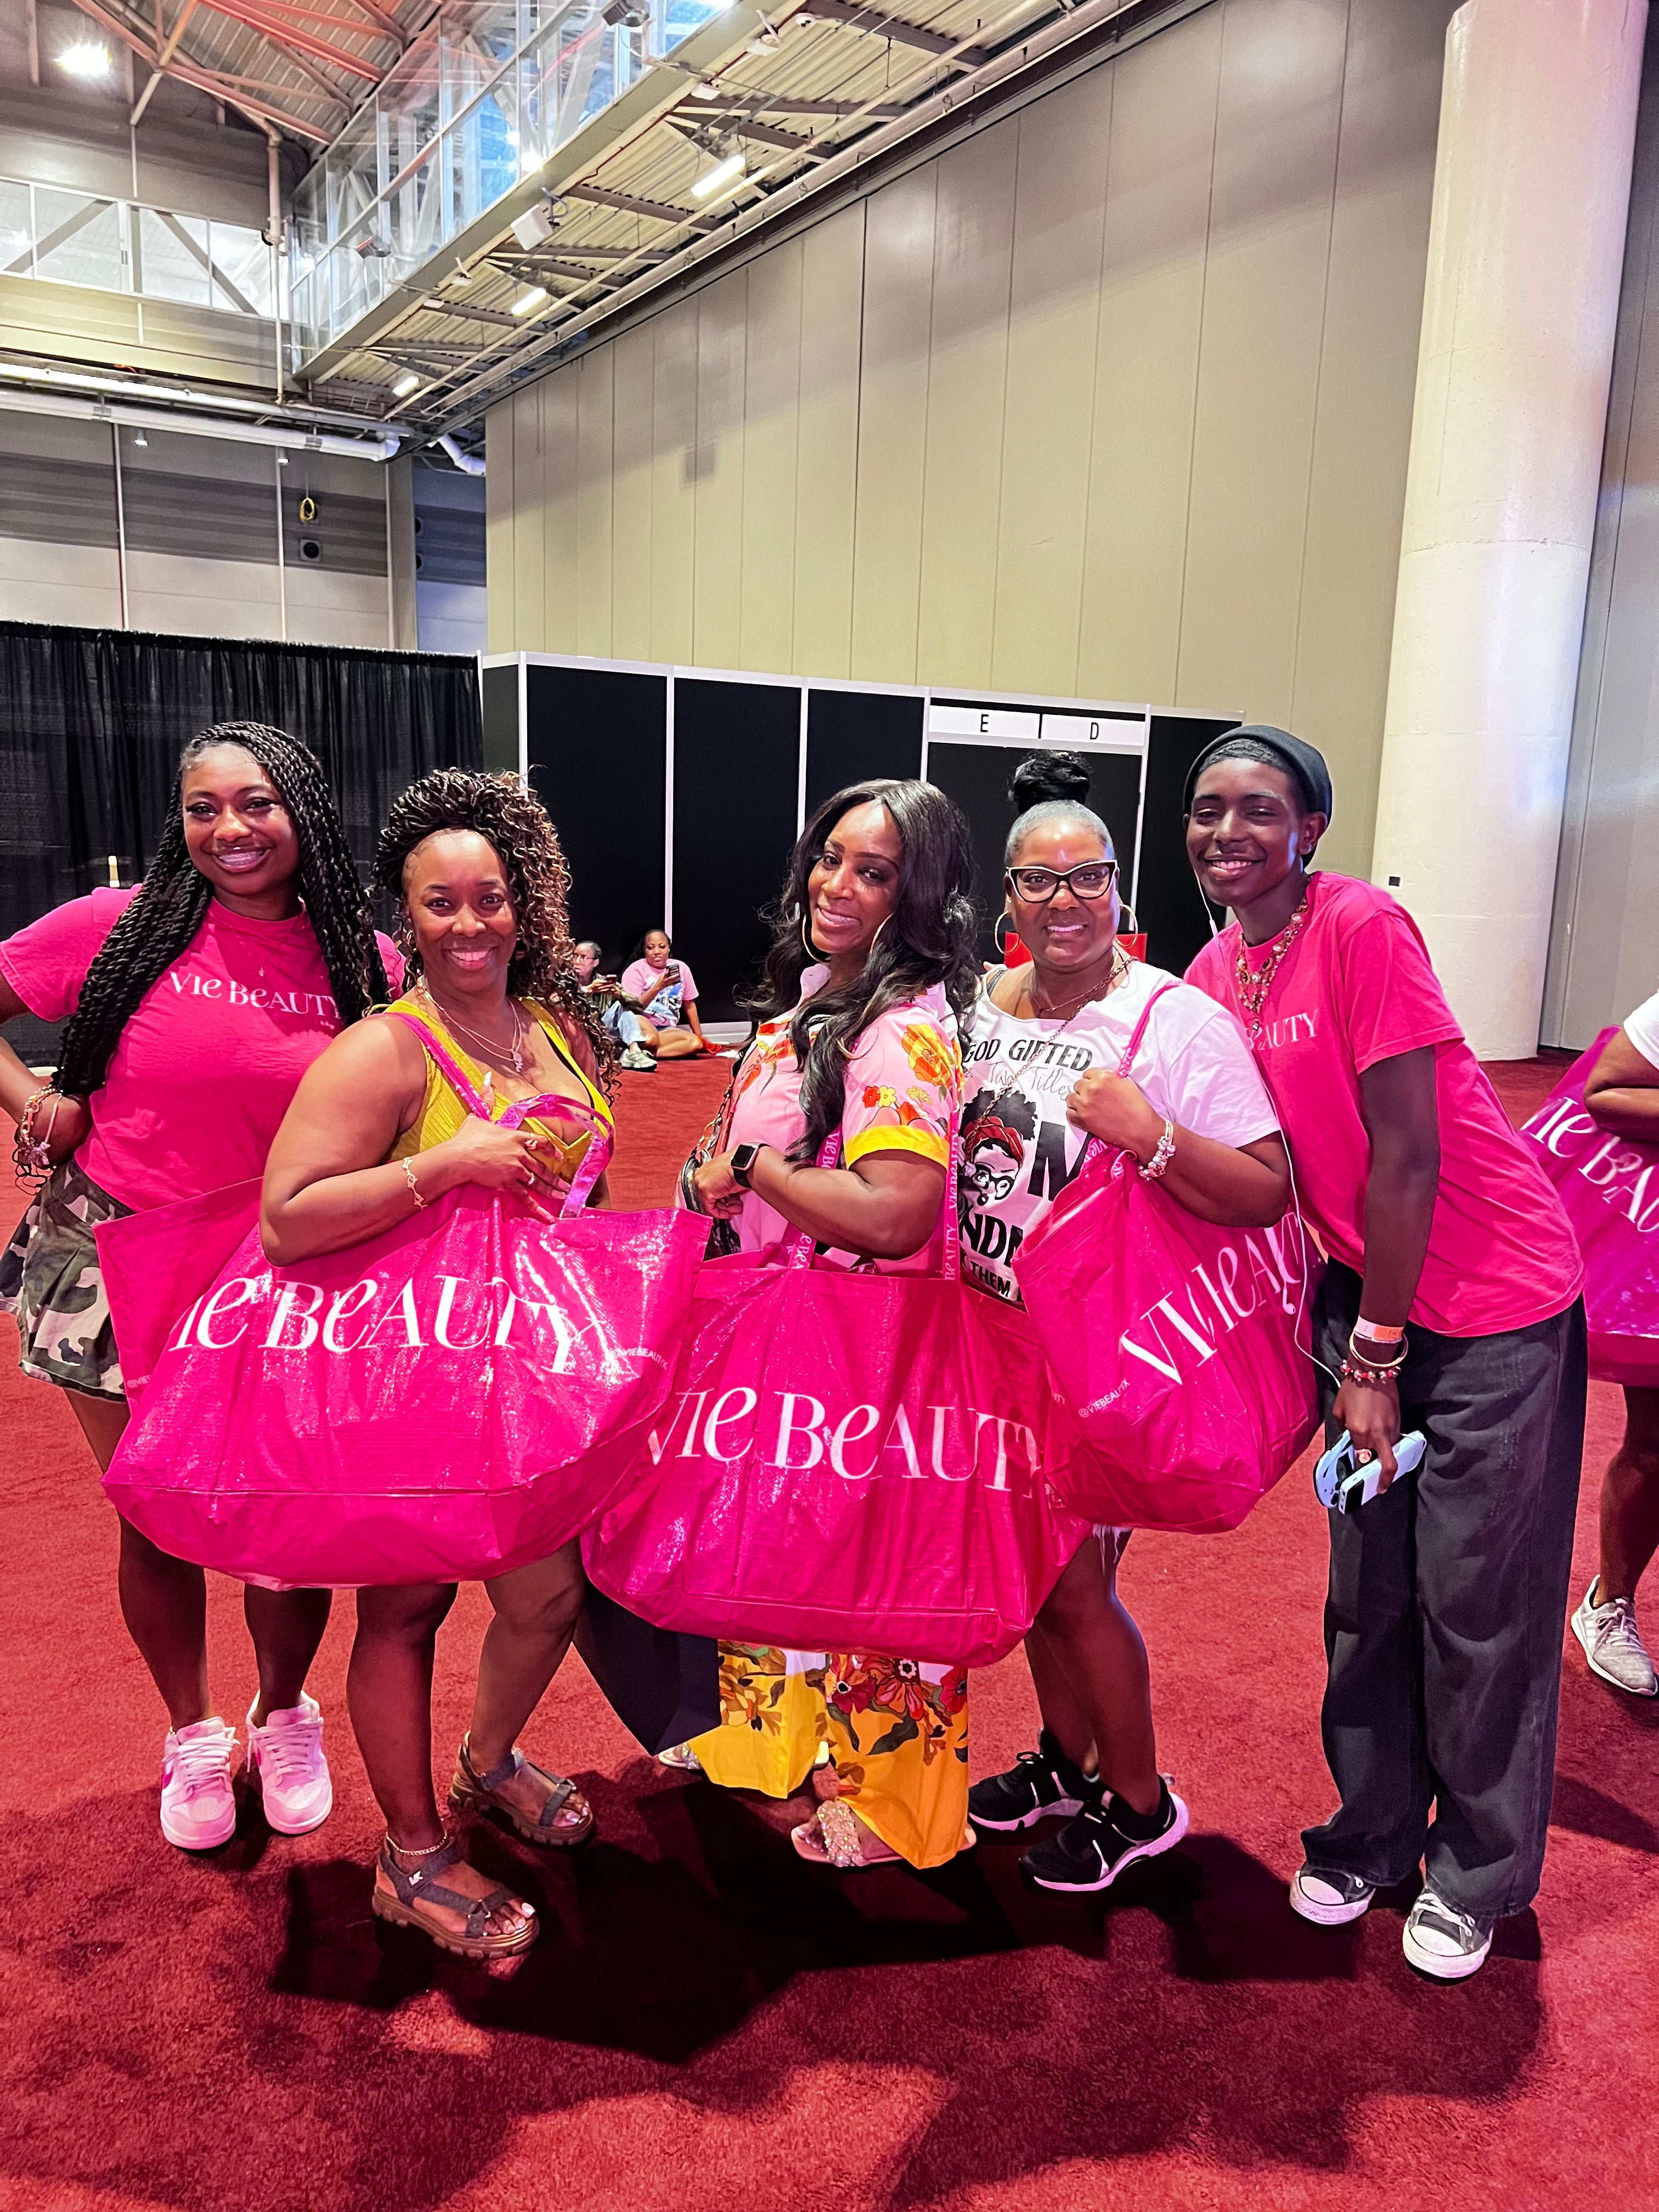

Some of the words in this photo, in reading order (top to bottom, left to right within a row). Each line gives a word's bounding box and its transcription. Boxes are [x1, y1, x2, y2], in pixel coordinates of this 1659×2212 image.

[980, 714, 989, 733] E
[1090, 722, 1099, 741] D
[964, 1039, 1001, 1063] GOD
[1008, 1039, 1094, 1071] GIFTED
[970, 1260, 1011, 1297] THEM
